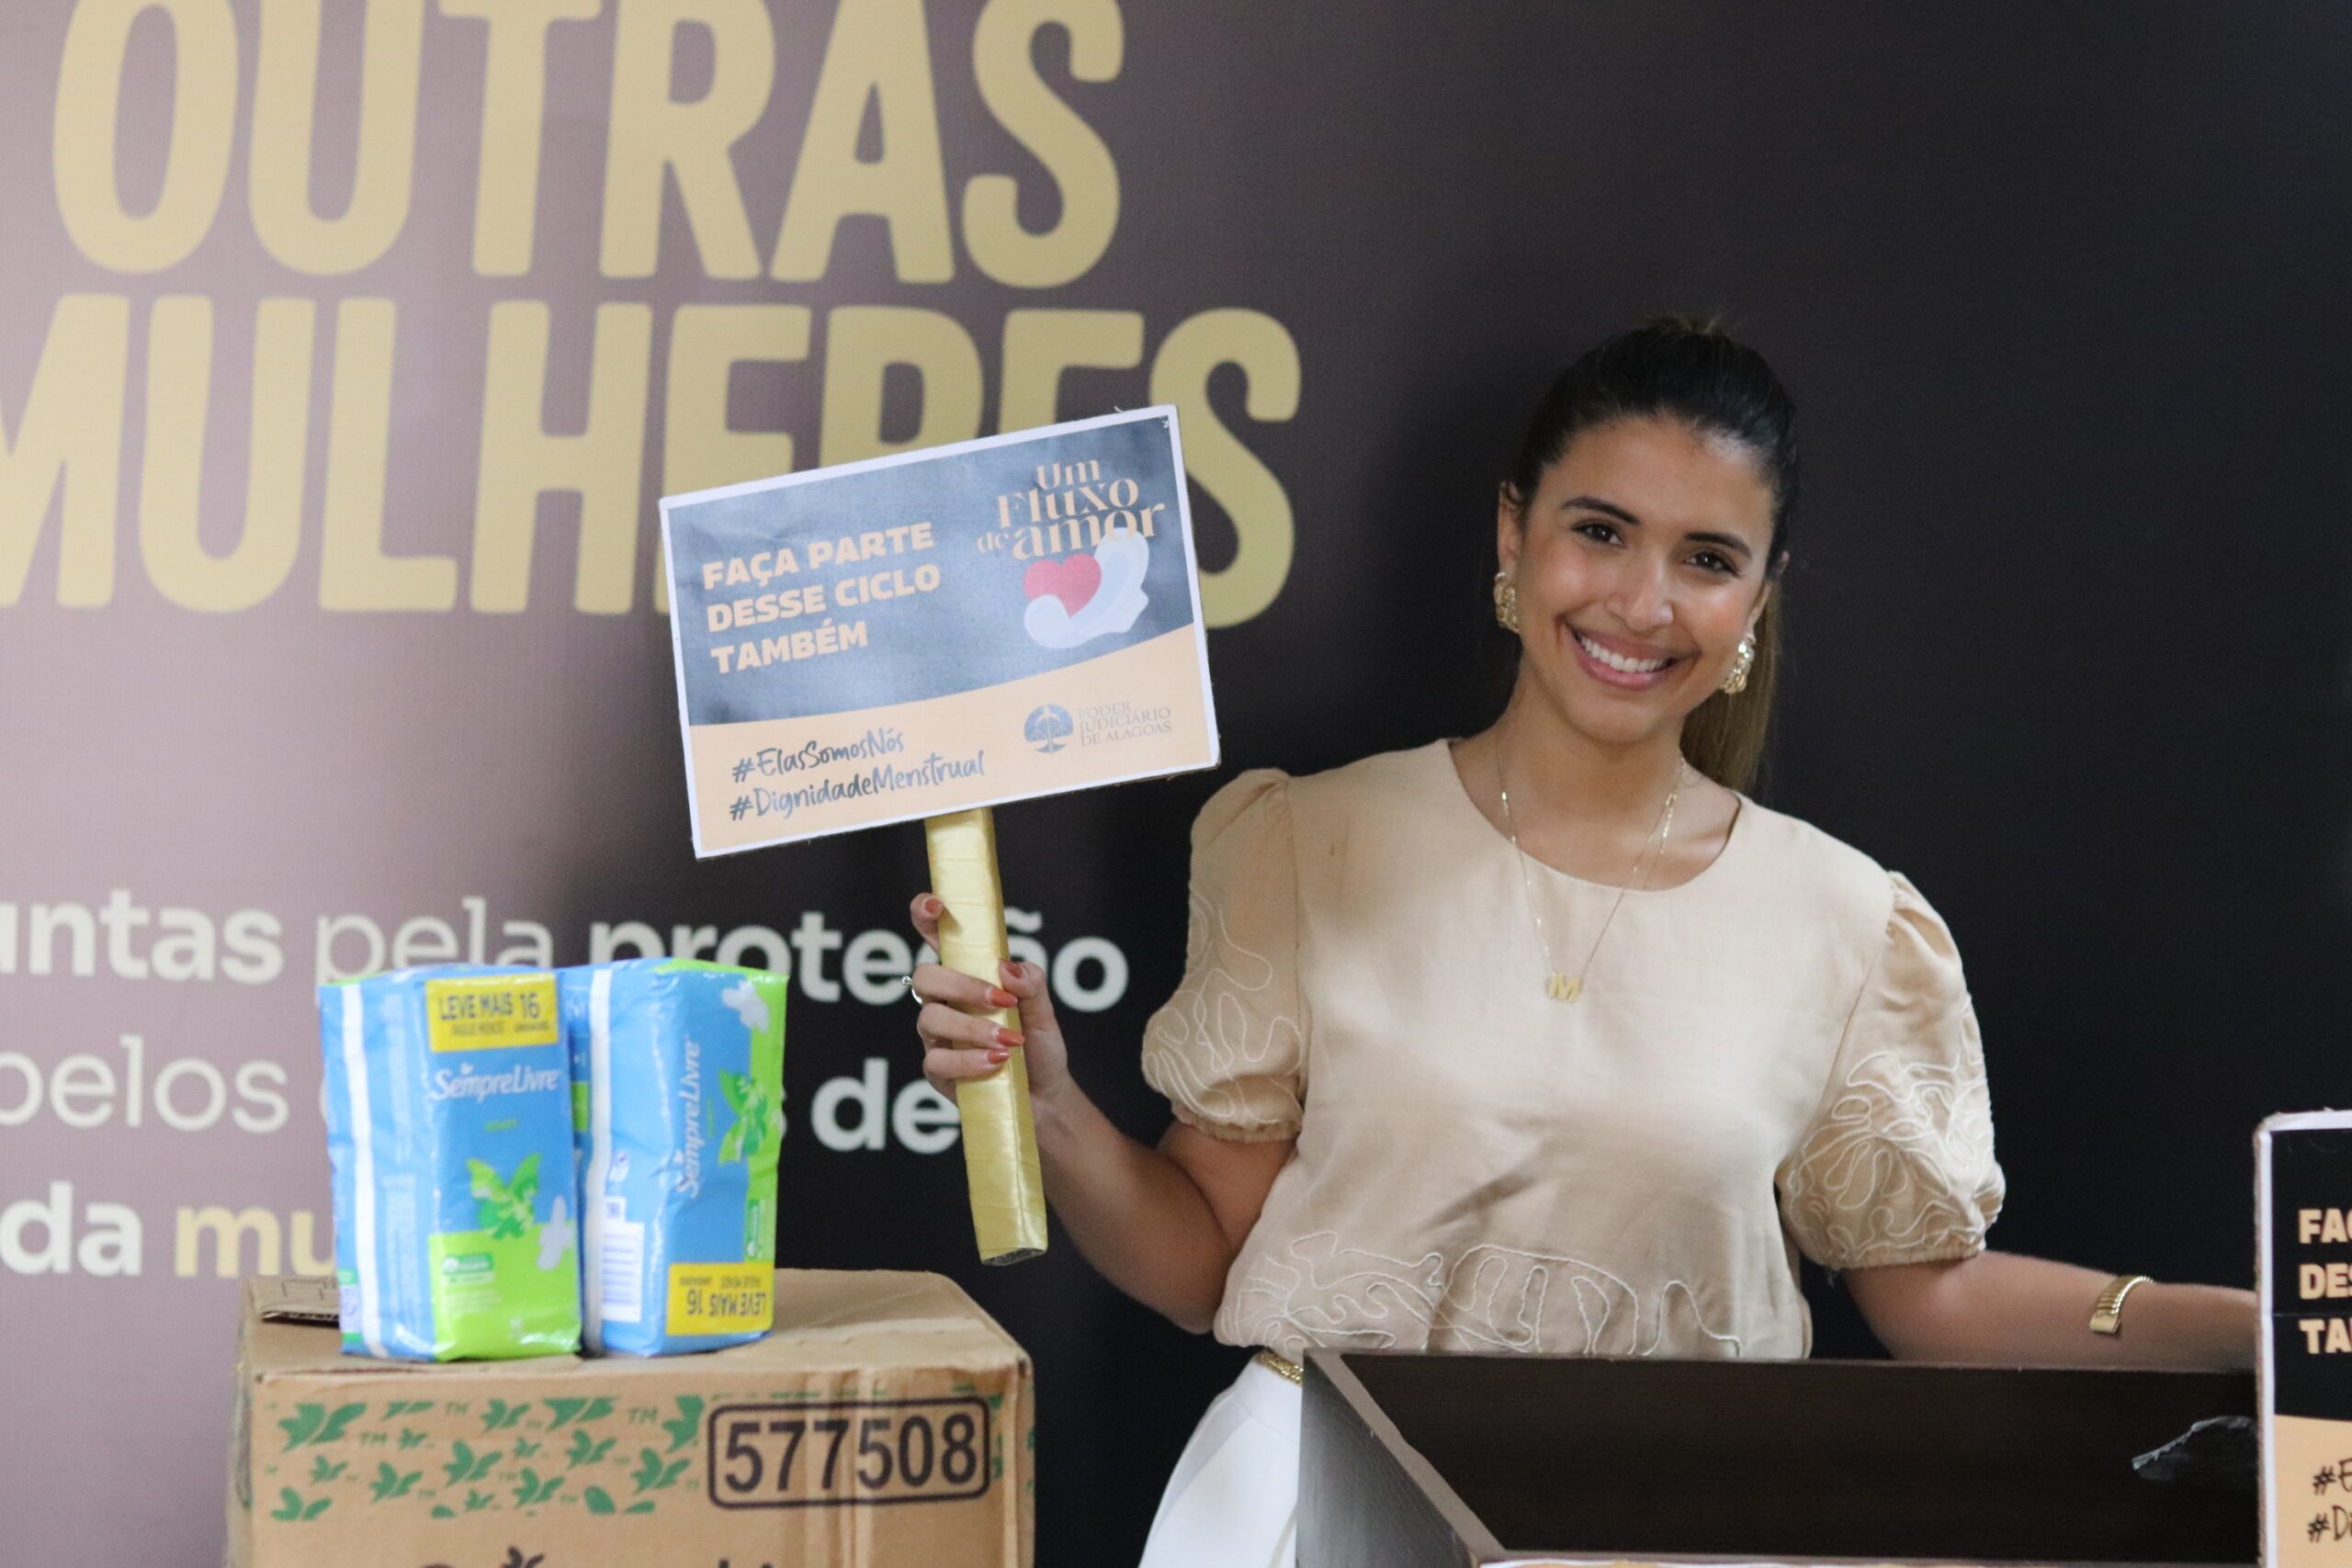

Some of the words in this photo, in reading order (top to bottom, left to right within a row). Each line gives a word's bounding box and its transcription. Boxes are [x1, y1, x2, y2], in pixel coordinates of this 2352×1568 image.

[52, 0, 1125, 288] OUTRAS
[1036, 459, 1101, 490] Um
[998, 479, 1139, 528] Fluxo
[1012, 502, 1166, 560] amor
[703, 548, 800, 589] FAÇA
[808, 521, 934, 570] PARTE
[707, 584, 826, 632] DESSE
[834, 564, 941, 606] CICLO
[710, 617, 869, 673] TAMBÉM
[1079, 701, 1132, 720] PODER
[1080, 706, 1171, 735] JUDICIÁRIO
[1080, 734, 1102, 748] DE
[1105, 720, 1172, 743] ALAGOAS
[731, 728, 905, 783] #ElasSomosNós
[729, 750, 985, 820] #DignidadeMenstrual
[0, 888, 285, 985] ntas
[439, 995, 478, 1021] LEVE
[480, 992, 514, 1018] MAIS
[519, 991, 541, 1020] 16
[809, 1057, 963, 1154] de
[2299, 1208, 2352, 1245] FA
[686, 1290, 704, 1316] 16
[724, 1412, 978, 1494] 577508
